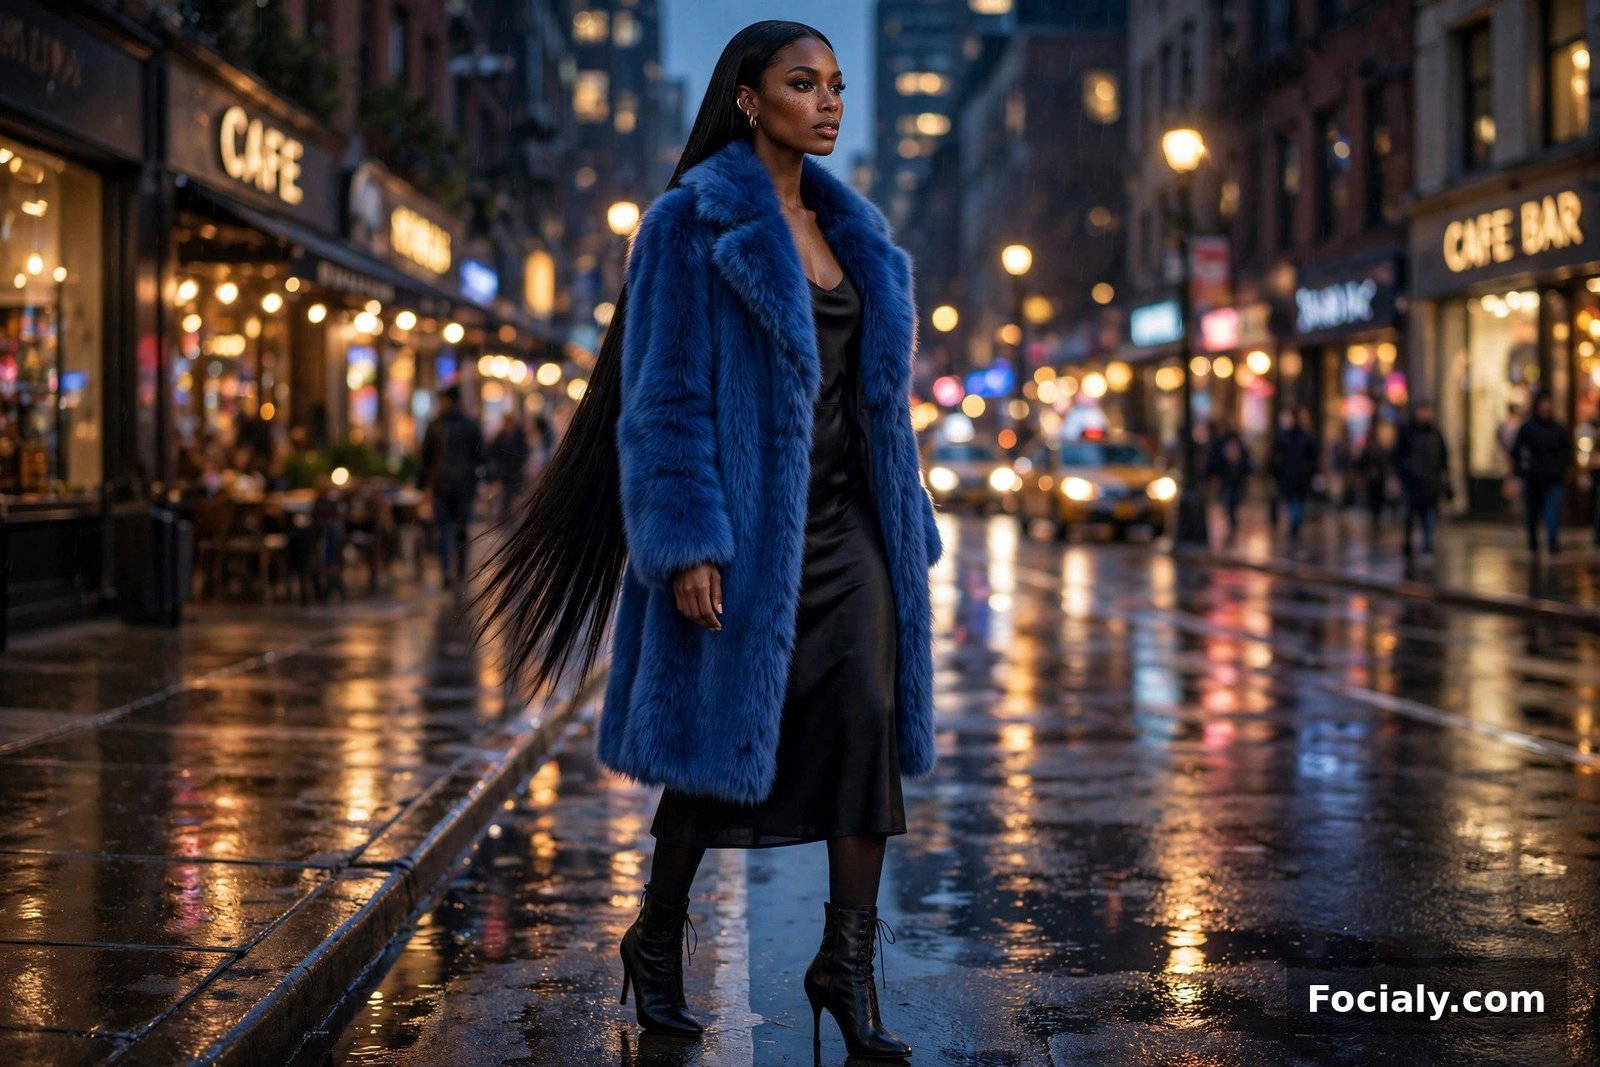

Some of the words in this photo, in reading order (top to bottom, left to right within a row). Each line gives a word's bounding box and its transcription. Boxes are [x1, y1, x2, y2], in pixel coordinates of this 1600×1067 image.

[220, 106, 304, 205] CAFE
[1443, 208, 1514, 272] CAFE
[1521, 191, 1584, 256] BAR
